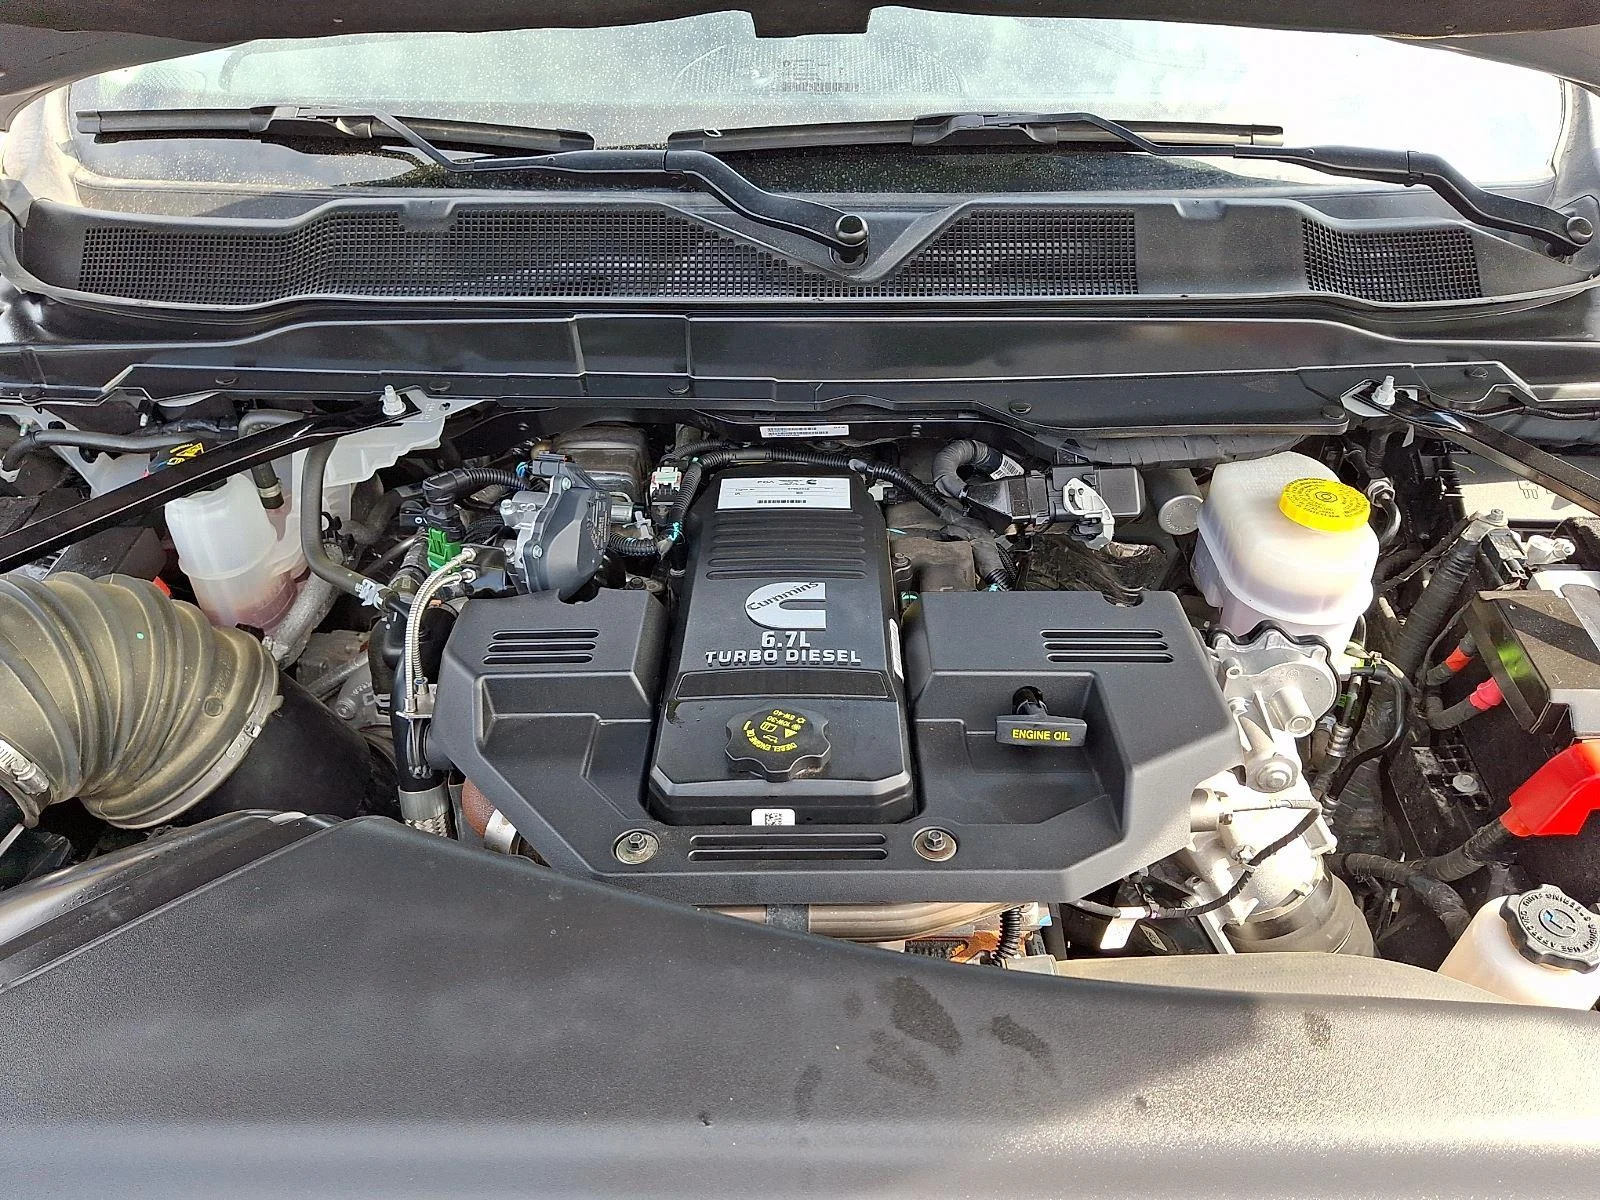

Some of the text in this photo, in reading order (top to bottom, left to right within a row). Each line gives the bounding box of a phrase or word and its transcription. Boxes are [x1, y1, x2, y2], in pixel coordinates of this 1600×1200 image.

[747, 581, 820, 611] Cummins
[761, 631, 812, 649] 6.7L
[705, 650, 862, 665] TURBO DIESEL
[1012, 729, 1071, 741] ENGINE OIL
[772, 741, 798, 752] DIESEL
